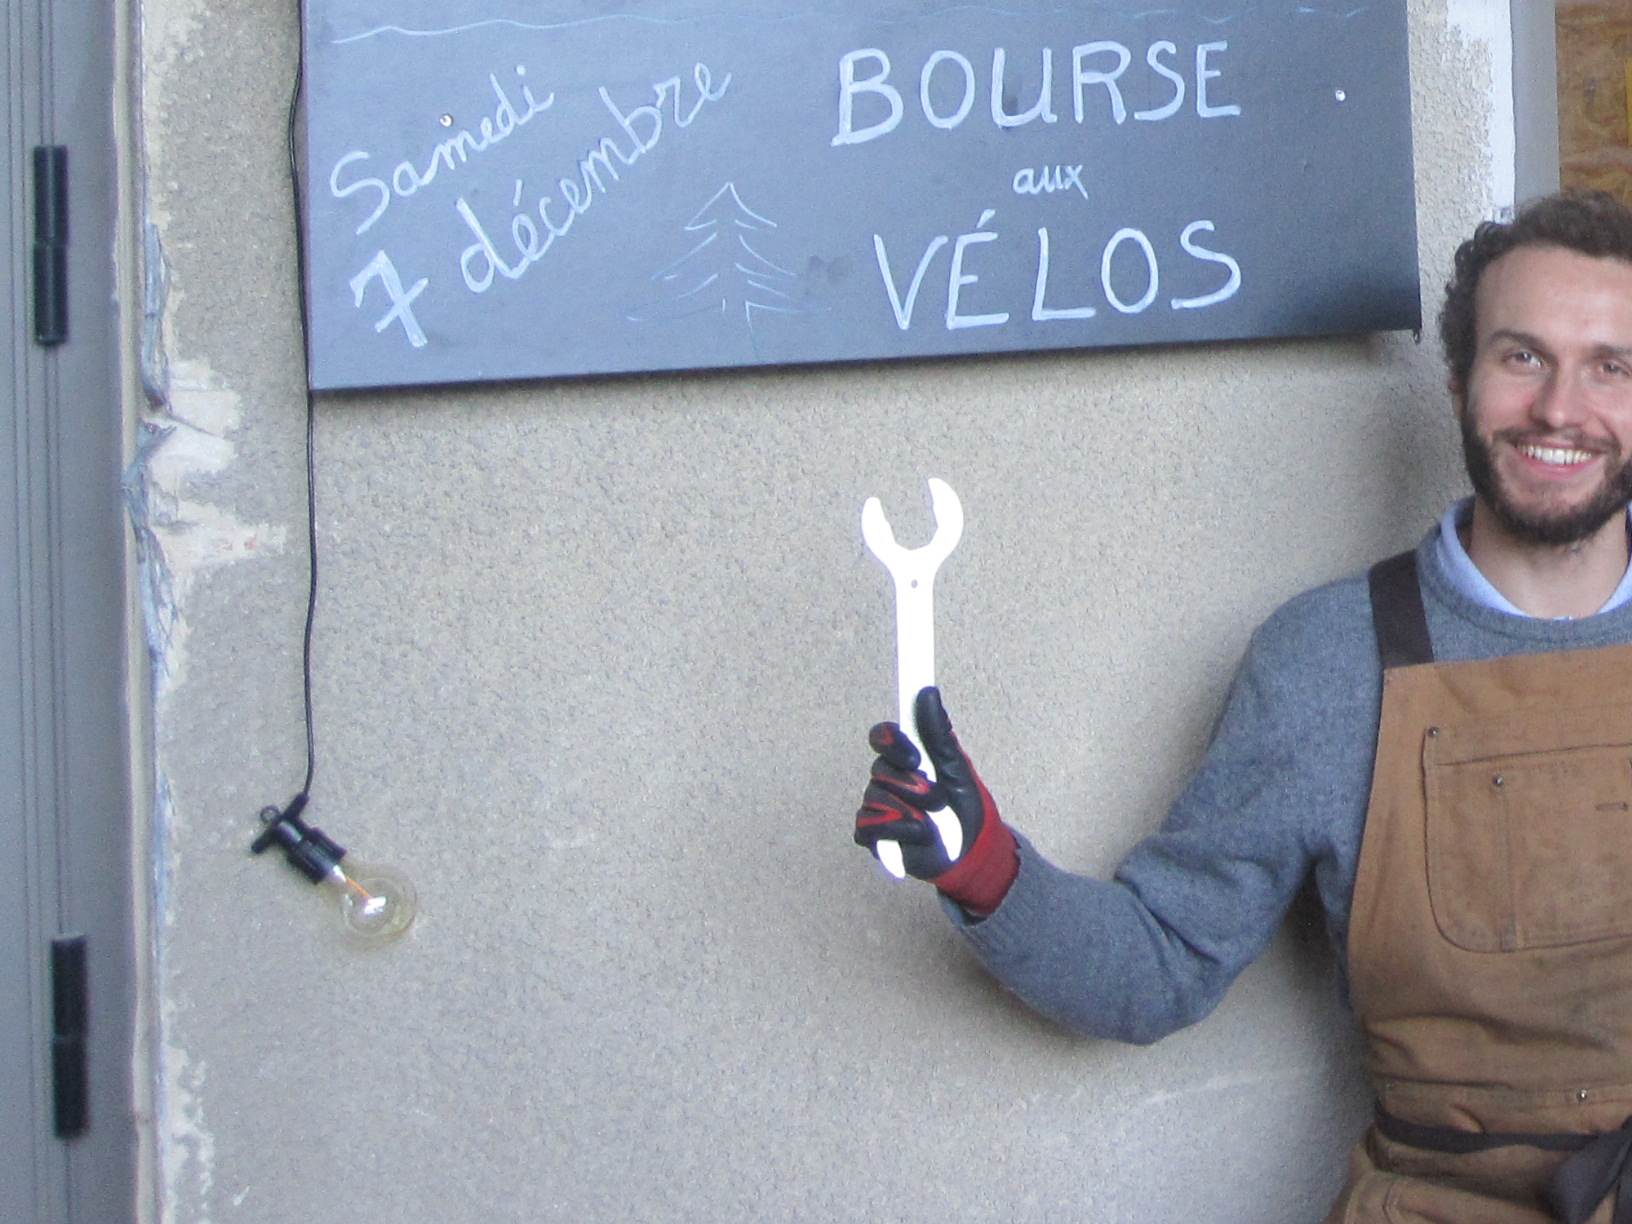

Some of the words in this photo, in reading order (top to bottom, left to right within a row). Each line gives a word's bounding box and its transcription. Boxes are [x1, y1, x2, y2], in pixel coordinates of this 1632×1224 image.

[330, 63, 555, 236] Samedi
[831, 40, 1243, 146] BOURSE
[349, 249, 429, 348] 7
[456, 61, 733, 294] décembre
[1012, 163, 1090, 200] aux
[873, 208, 1243, 331] VÉLOS
